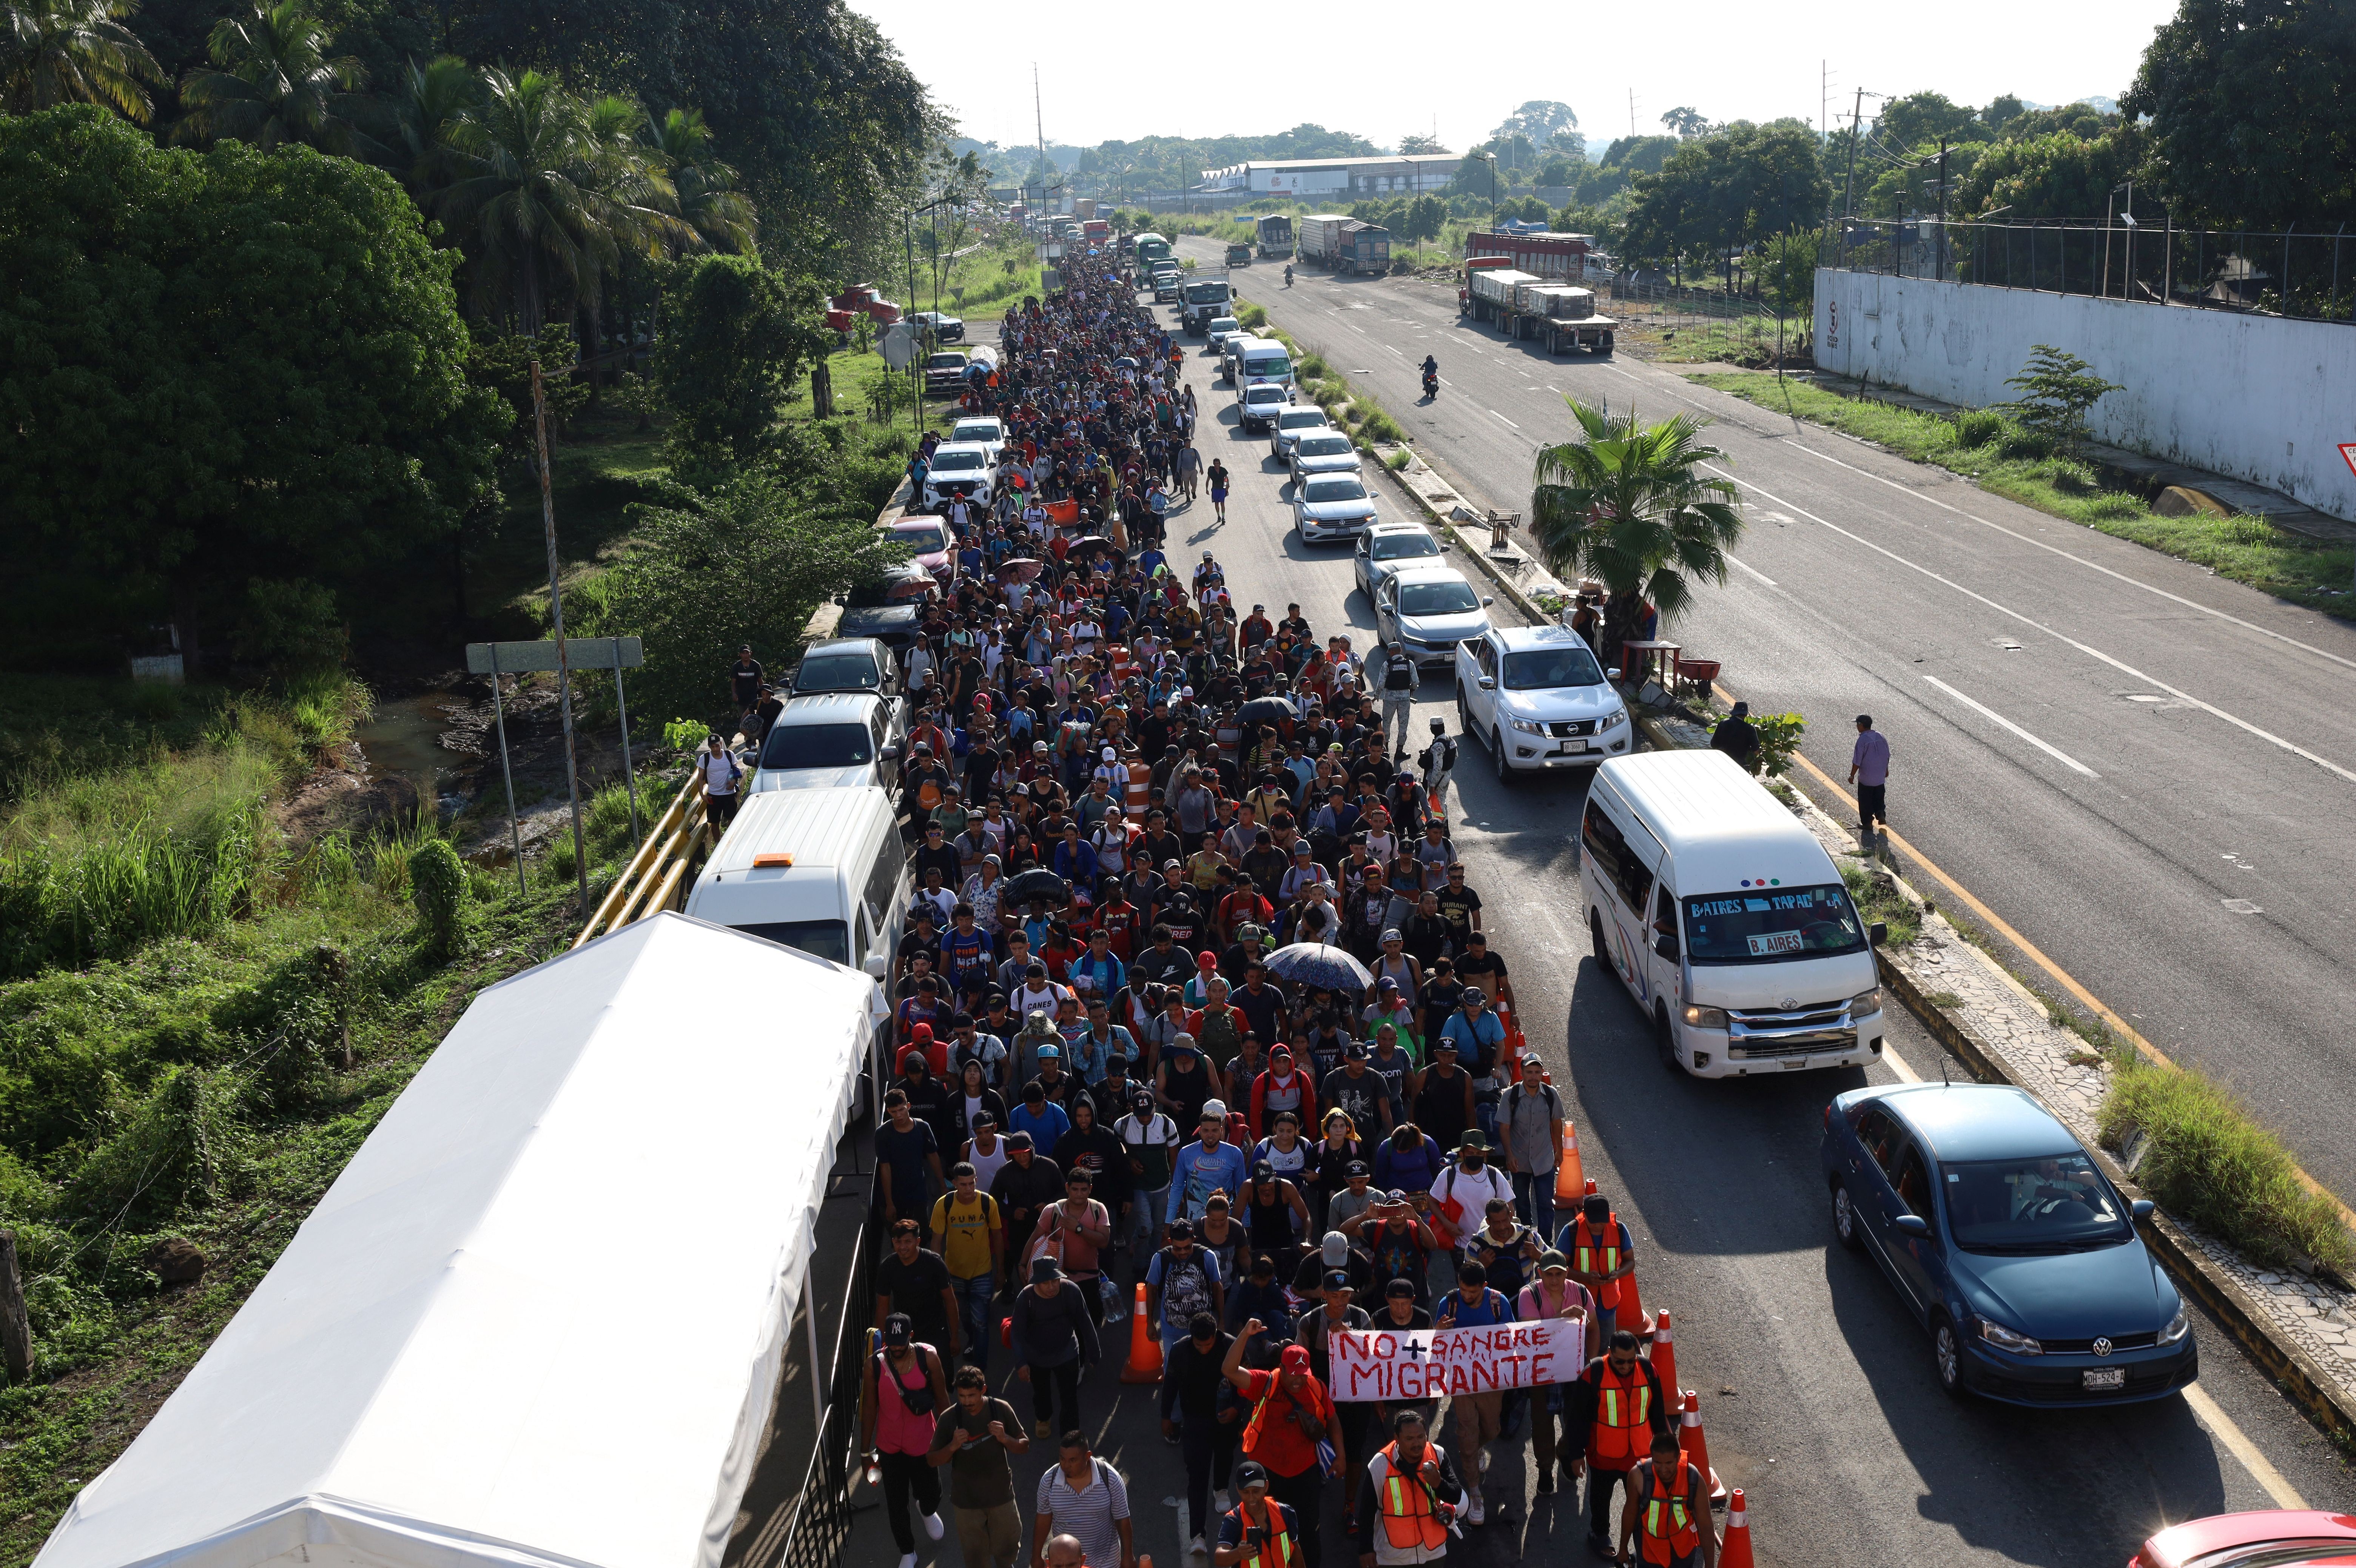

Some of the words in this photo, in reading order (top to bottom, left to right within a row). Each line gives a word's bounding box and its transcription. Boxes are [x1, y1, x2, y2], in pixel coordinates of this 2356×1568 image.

[1750, 940, 1764, 953] B.
[1767, 934, 1801, 953] AIRES
[1027, 1000, 1052, 1010] CANES
[1339, 1090, 1350, 1099] 23
[950, 1213, 984, 1223] PUMA
[891, 1322, 902, 1334] NY
[1339, 1333, 1397, 1361] NO
[1402, 1338, 1427, 1360] +
[1431, 1327, 1551, 1357] SANGRE
[1350, 1353, 1555, 1398] MIGRANTE
[2083, 1372, 2125, 1384] MDH-524-A
